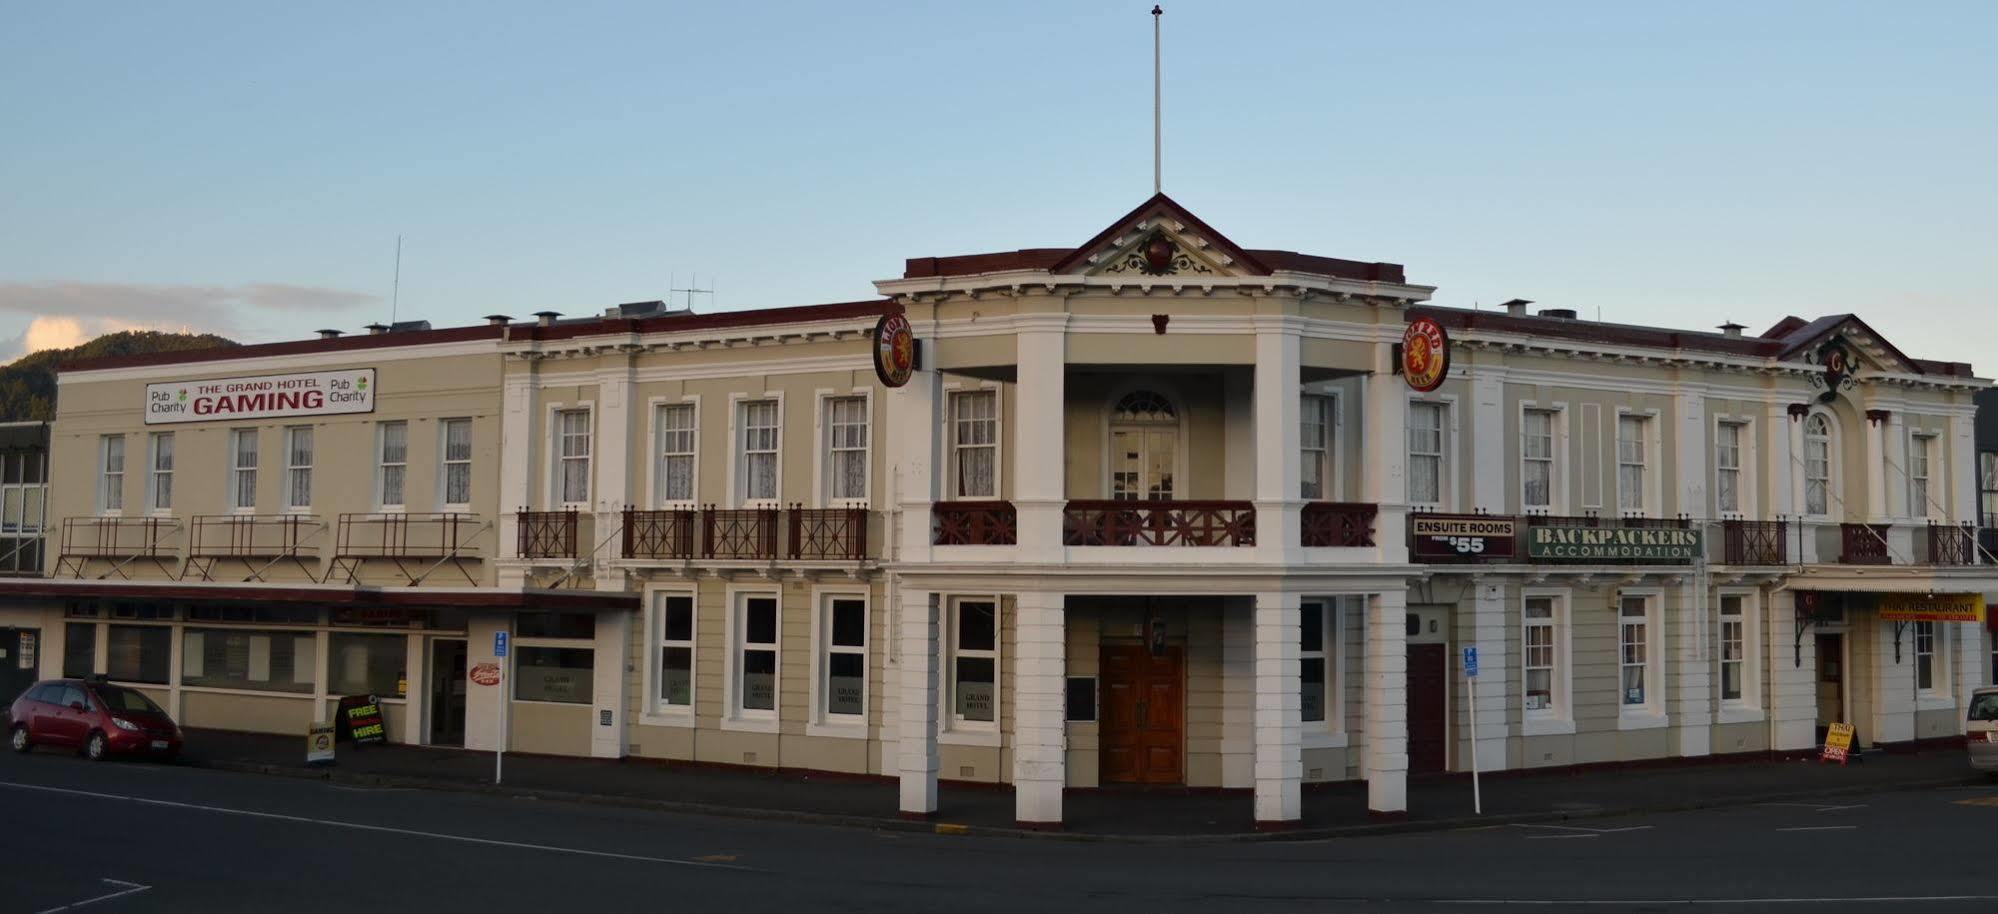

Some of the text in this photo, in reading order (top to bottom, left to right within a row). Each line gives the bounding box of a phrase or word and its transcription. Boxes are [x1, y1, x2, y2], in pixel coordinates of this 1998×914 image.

[198, 378, 321, 395] THE GRAND HOTEL
[331, 379, 350, 390] Pub
[152, 391, 170, 401] Pub
[193, 390, 324, 415] GAMING
[330, 391, 367, 404] Charity
[151, 401, 187, 414] Charity
[1417, 521, 1512, 534] ENSUITE ROOMS
[1536, 528, 1697, 545] BACKPACKERS
[1449, 536, 1484, 553] $55
[1542, 545, 1692, 557] ACCOMMODATION
[965, 693, 990, 702] GRAND
[348, 704, 378, 719] FREE
[353, 724, 383, 738] HIRE
[1824, 747, 1845, 756] OPEN
